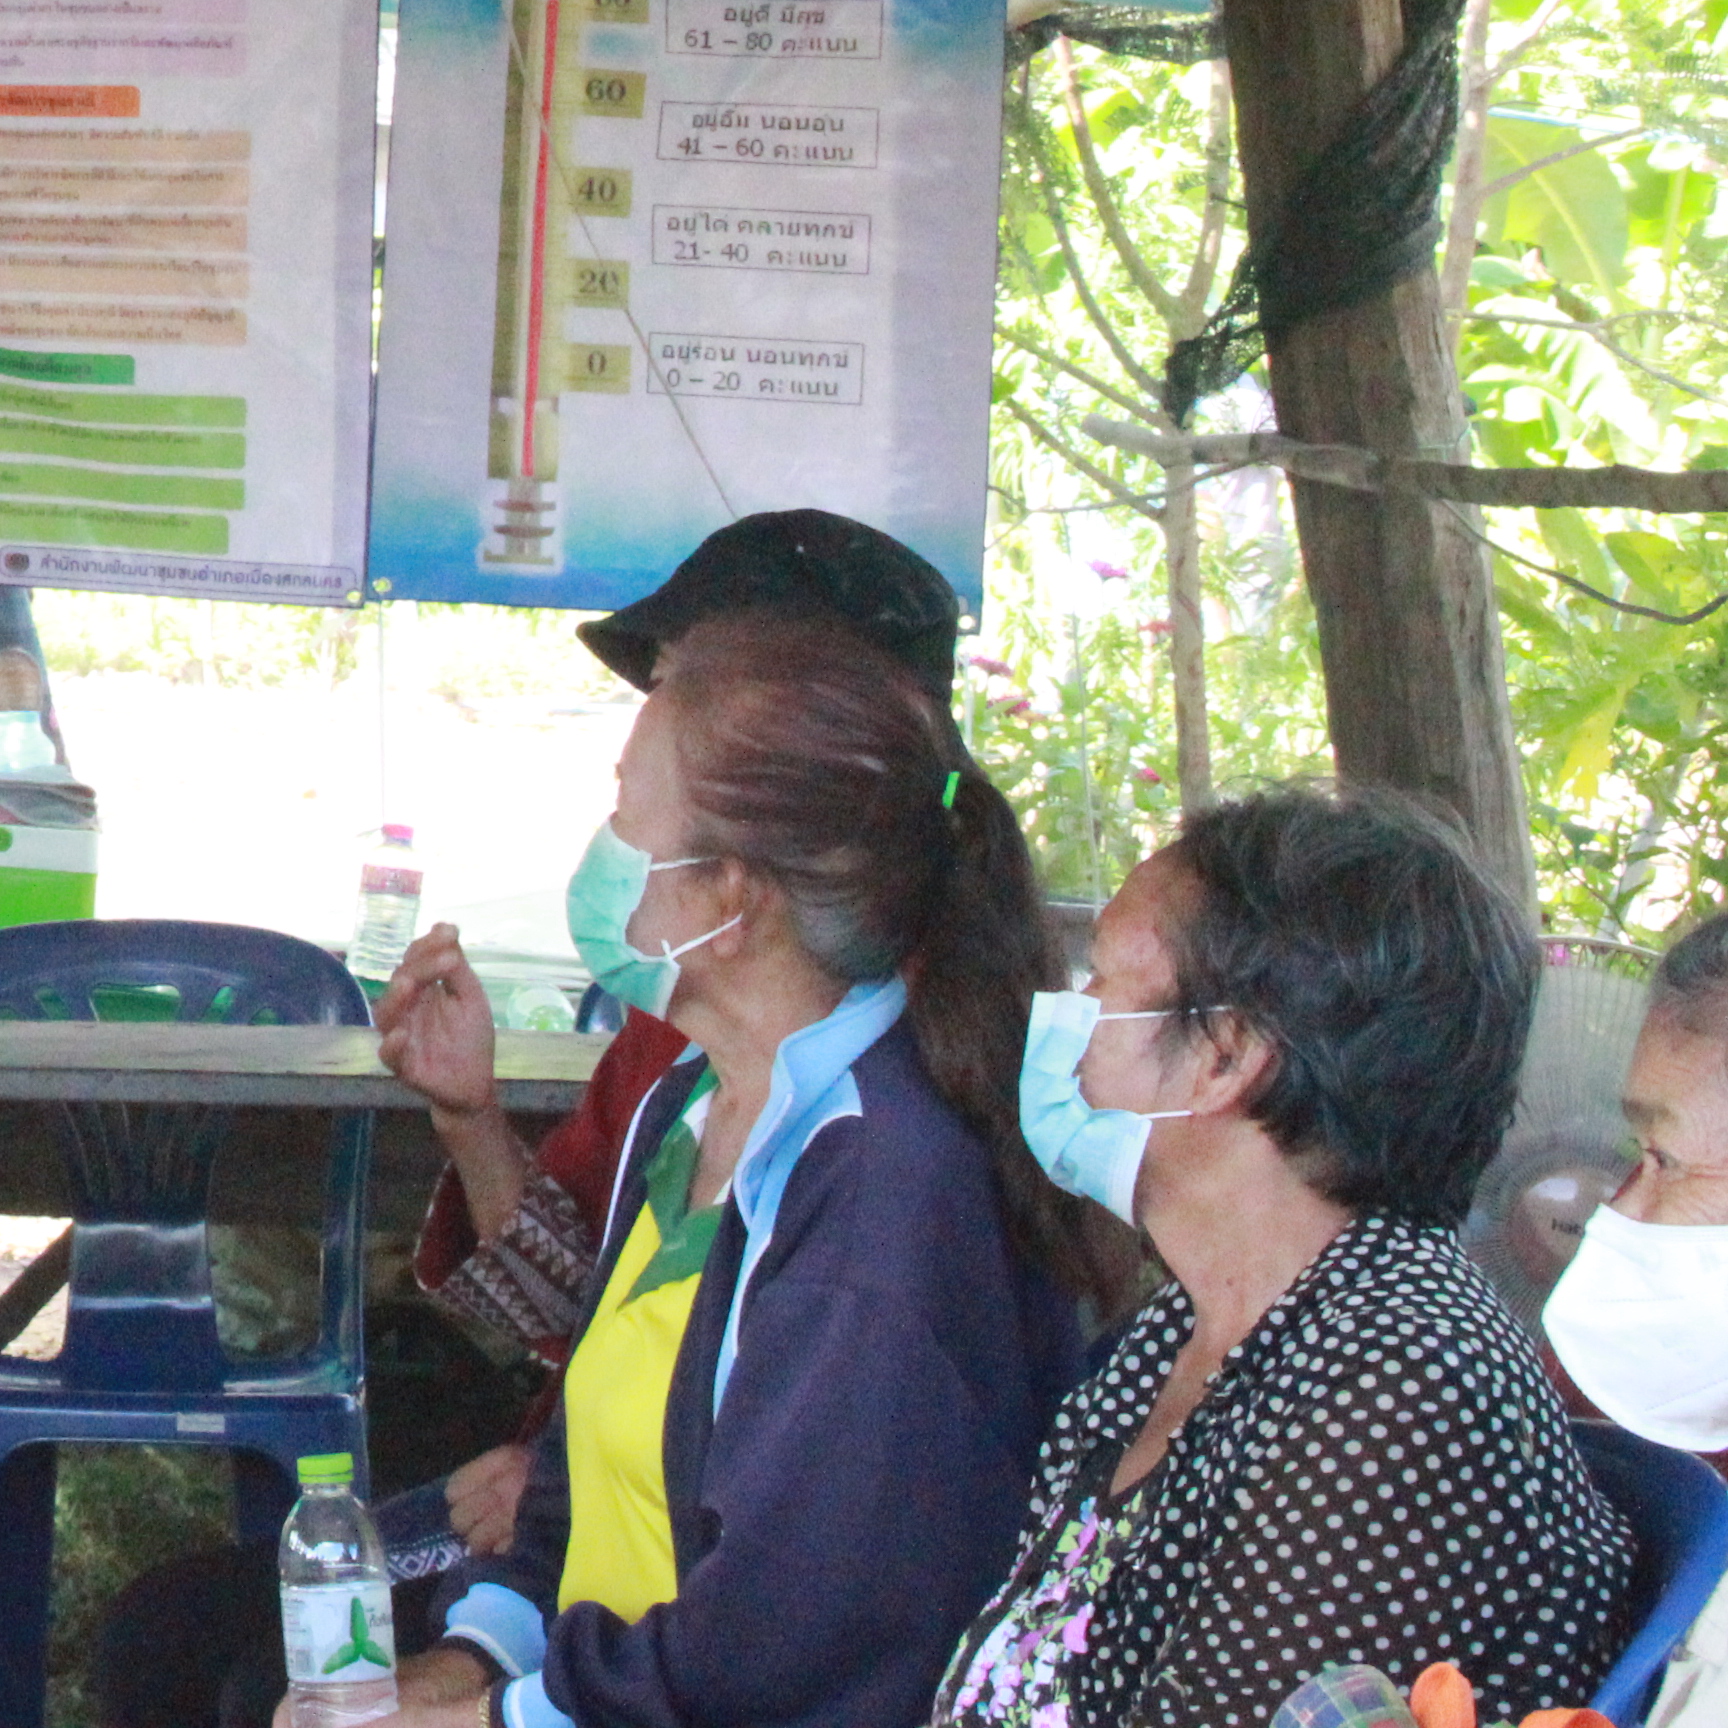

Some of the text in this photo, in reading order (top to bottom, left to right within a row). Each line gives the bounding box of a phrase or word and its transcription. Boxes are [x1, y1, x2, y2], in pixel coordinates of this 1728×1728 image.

[724, 3, 769, 27] อยู่ดี
[684, 30, 712, 50] 61
[746, 32, 773, 51] 80
[782, 35, 858, 53] คะแนน
[585, 78, 627, 103] 60
[677, 136, 701, 155] 41
[736, 138, 764, 157] 60
[773, 143, 854, 162] คะแนน
[578, 177, 617, 202] 40
[721, 243, 749, 263] 40
[767, 248, 847, 267] คะแนน
[578, 269, 619, 295] 20
[588, 350, 607, 376] 0
[667, 368, 681, 387] 0
[713, 371, 741, 391] 20
[759, 377, 839, 396] คะแนน
